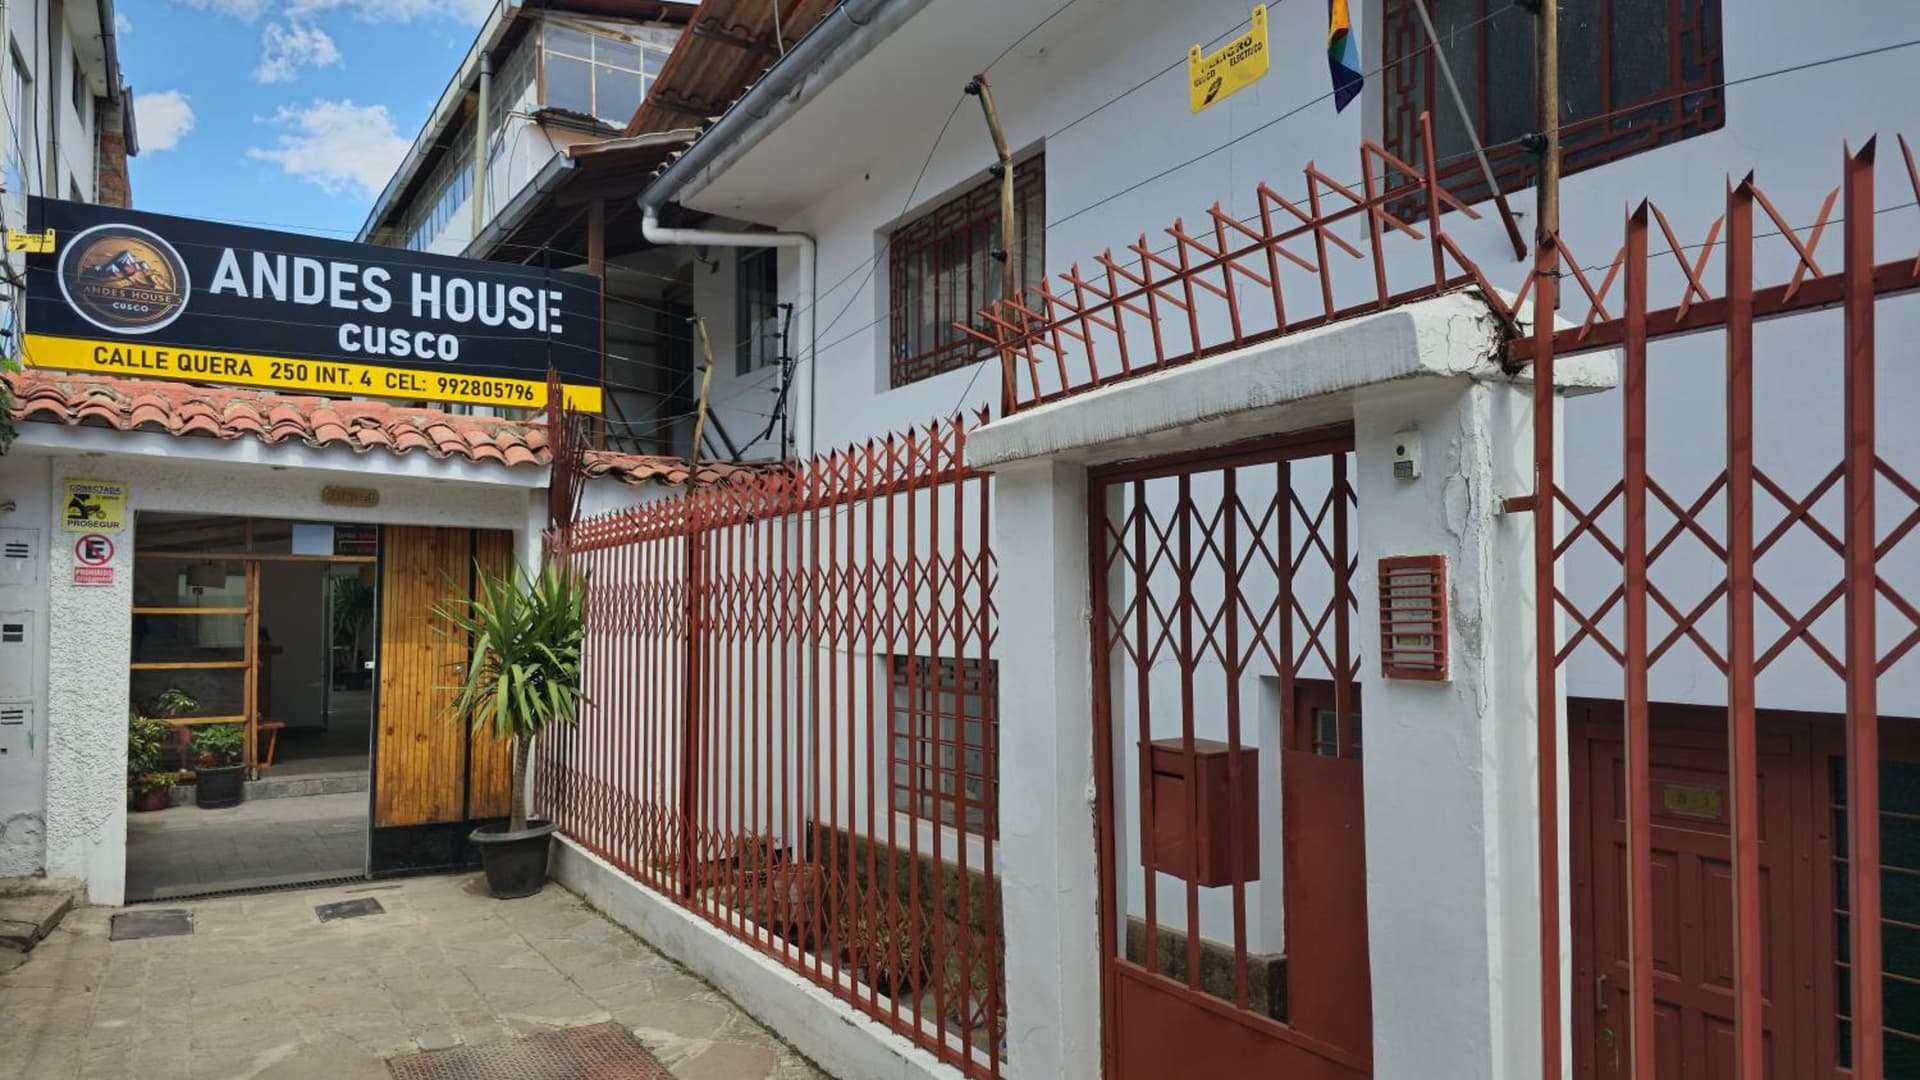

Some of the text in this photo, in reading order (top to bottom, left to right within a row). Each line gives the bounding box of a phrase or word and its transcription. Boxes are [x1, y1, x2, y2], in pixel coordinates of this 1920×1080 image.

[83, 286, 171, 303] ANDES HOUSE
[209, 247, 563, 334] ANDES HOUSE
[94, 346, 534, 401] CALLE QUERA 250 INT. 4 CEL: 992805796
[67, 519, 121, 529] PROSEGUR
[86, 541, 105, 559] E
